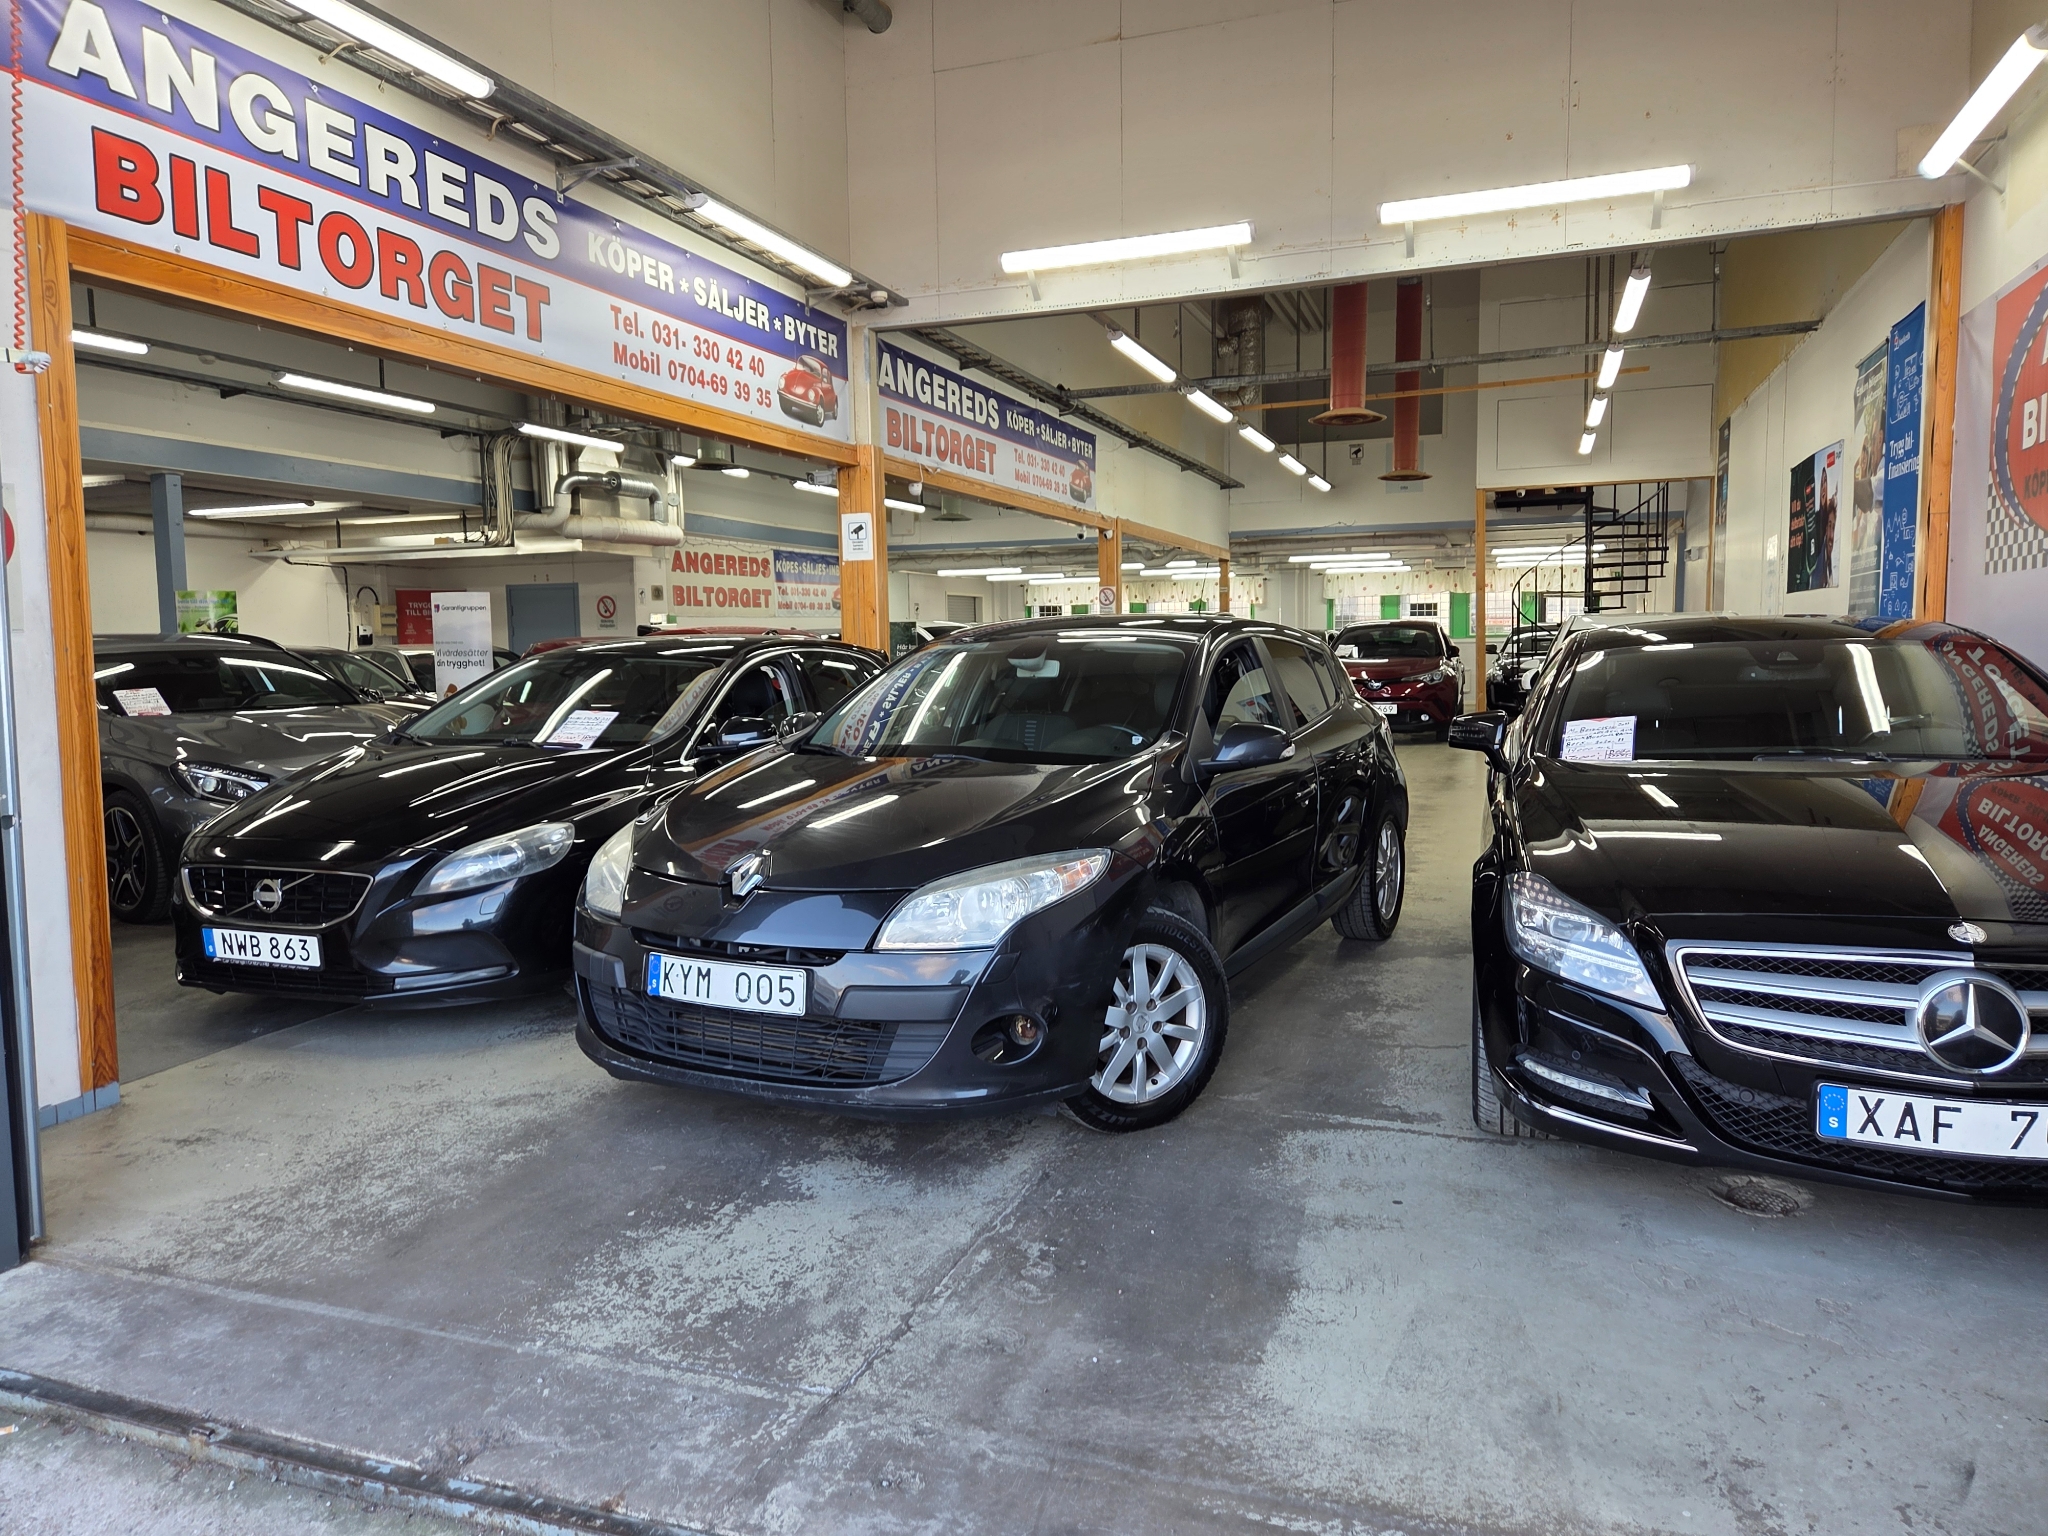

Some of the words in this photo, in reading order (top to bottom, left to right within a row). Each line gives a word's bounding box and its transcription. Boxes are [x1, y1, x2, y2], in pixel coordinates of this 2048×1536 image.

[48, 2, 561, 260] ANGEREDS
[91, 126, 550, 343] BILTORGET
[588, 231, 675, 295] KÖPER
[693, 277, 770, 332] SÄLJER
[783, 314, 838, 359] BYTER
[610, 304, 644, 338] Tel.
[652, 320, 687, 350] 031-
[693, 335, 720, 363] 330
[726, 347, 743, 371] 42
[749, 354, 765, 378] 40
[613, 342, 661, 376] Mobil
[668, 359, 728, 396] 0704-69
[734, 380, 751, 402] 39
[756, 387, 772, 408] 35
[878, 352, 1000, 430] ANGEREDS
[886, 407, 997, 476] BILTORGET
[1006, 409, 1035, 437] KÖPER
[1041, 423, 1067, 450] SÄLJER
[1072, 437, 1093, 459] BYTER
[1890, 438, 1904, 460] Trygg
[1014, 448, 1025, 464] Tel.
[1052, 461, 1058, 475] 42
[1015, 467, 1030, 485] Mobil
[671, 550, 771, 579] ANGEREDS
[672, 585, 772, 608] BILTORGET
[446, 659, 485, 669] trygghet!
[221, 932, 261, 958] NWB
[270, 937, 310, 962] 863
[662, 961, 711, 999] KYM
[735, 972, 796, 1007] 005
[1828, 1116, 1838, 1128] S
[1857, 1095, 1962, 1144] XAF
[2010, 1111, 2048, 1150] 7
